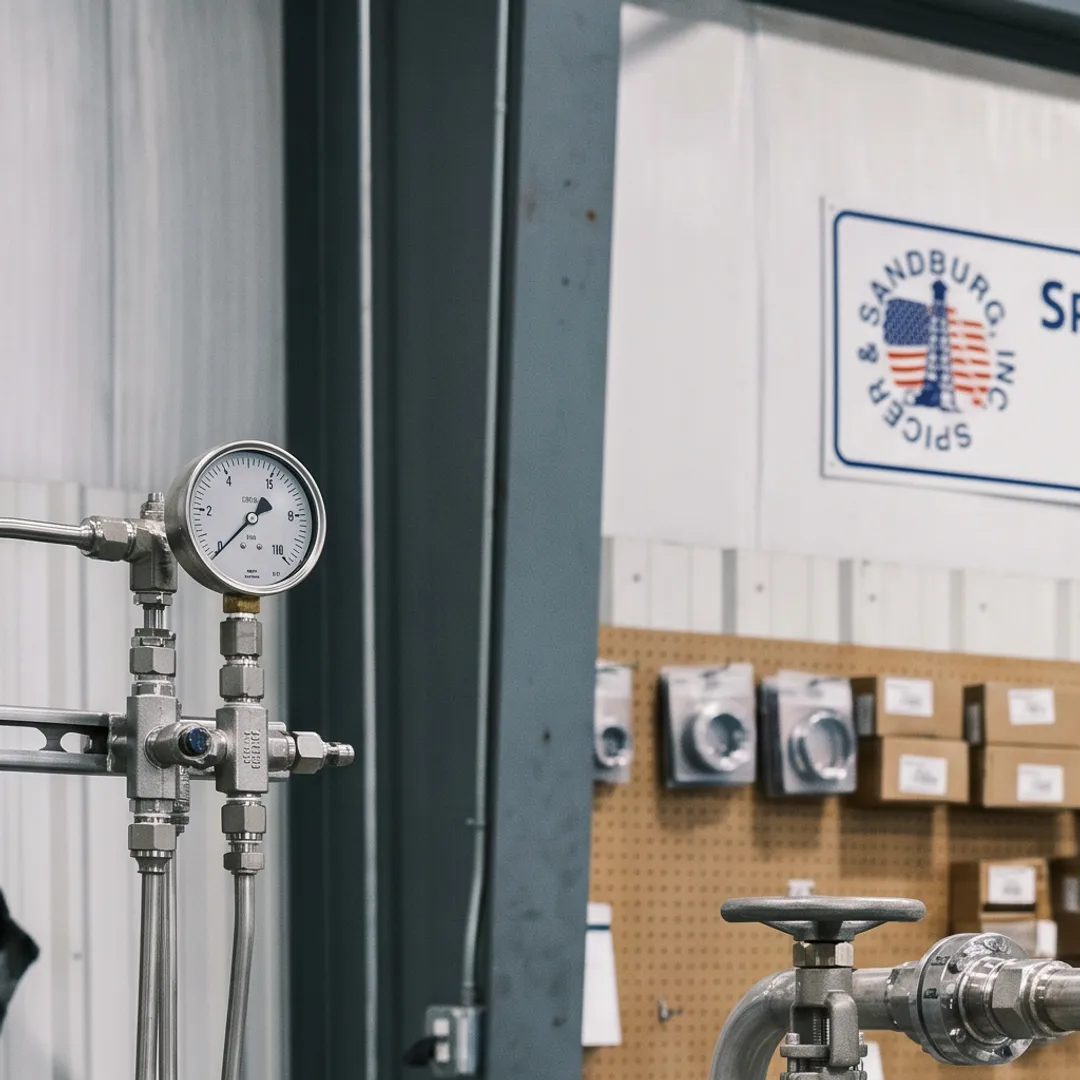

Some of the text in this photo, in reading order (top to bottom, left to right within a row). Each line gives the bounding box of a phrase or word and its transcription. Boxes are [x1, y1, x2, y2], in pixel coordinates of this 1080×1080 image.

[857, 343, 880, 363] &
[868, 378, 972, 451] SPICER
[226, 476, 232, 486] 4
[206, 506, 212, 516] 2
[287, 511, 294, 521] 8
